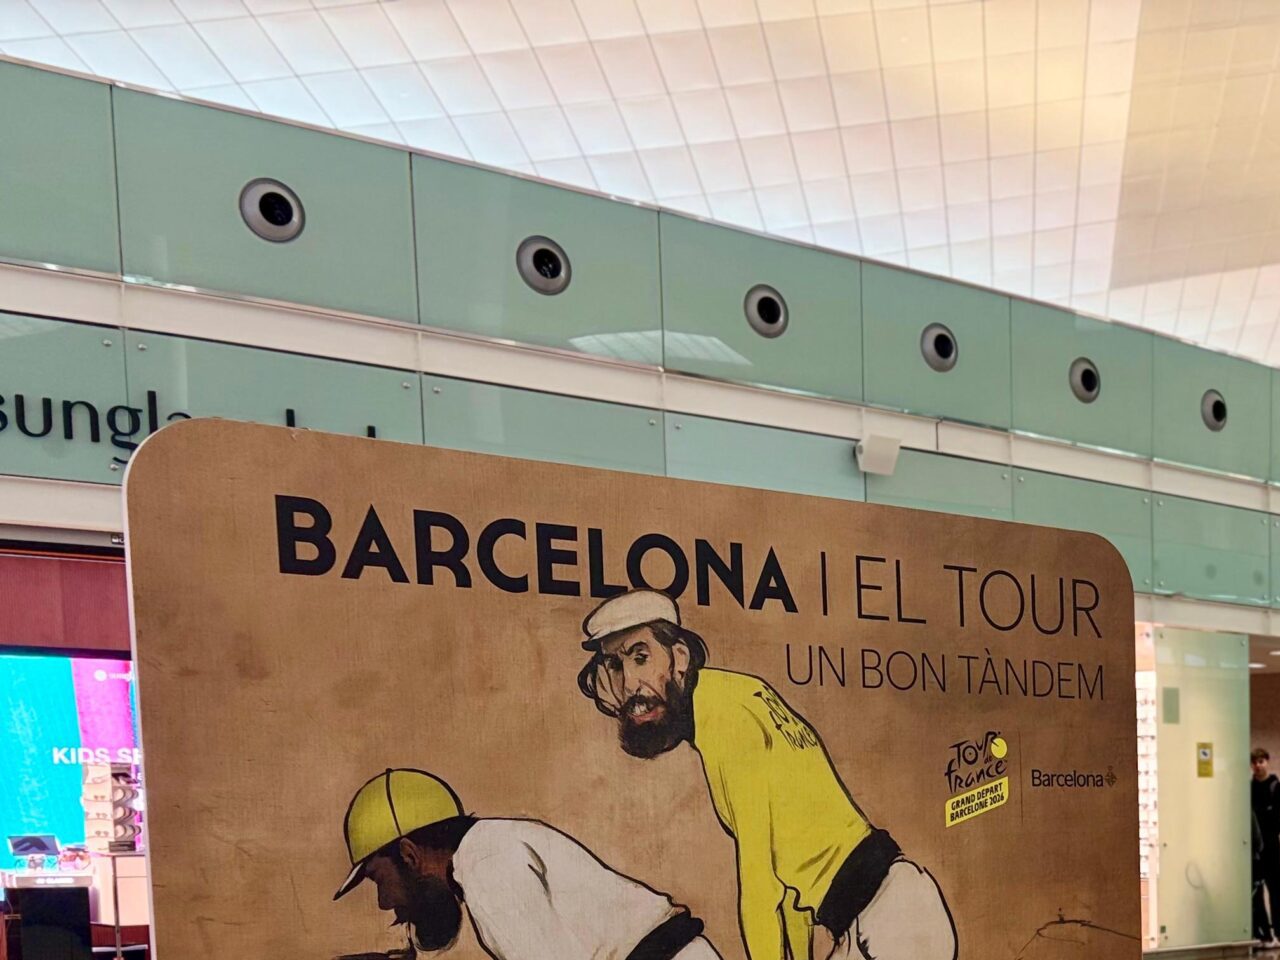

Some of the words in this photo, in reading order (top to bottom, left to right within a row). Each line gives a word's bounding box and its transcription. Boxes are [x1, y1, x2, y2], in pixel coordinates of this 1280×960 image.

[0, 390, 192, 464] ungl
[274, 494, 798, 614] BARCELONA
[855, 554, 927, 625] EL
[942, 564, 1102, 639] TOUR
[786, 643, 846, 688] UN
[860, 648, 947, 694] BON
[957, 647, 1104, 701] TÀNDEM
[53, 747, 110, 764] KIDS
[1031, 769, 1104, 787] Barcelona
[950, 801, 989, 822] BARCELONE
[989, 793, 1005, 809] 2026
[951, 792, 976, 811] GRAND
[977, 782, 1004, 804] DÉPART
